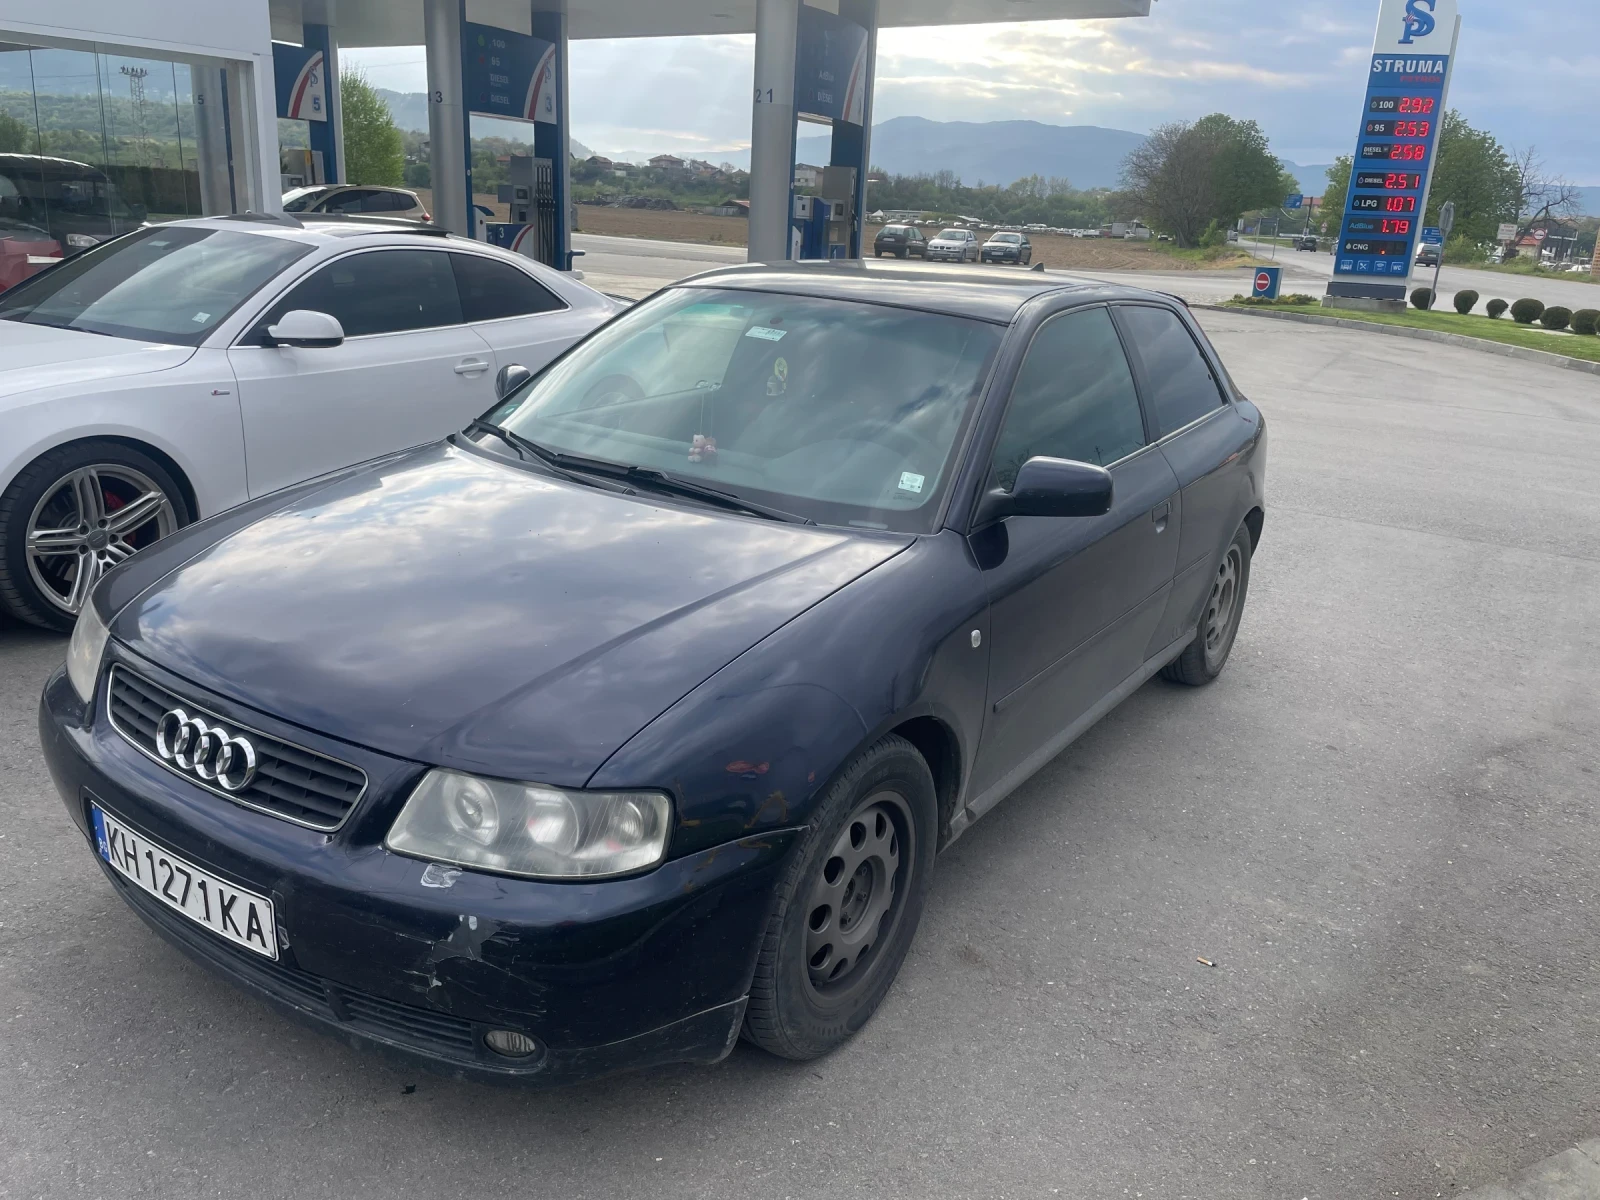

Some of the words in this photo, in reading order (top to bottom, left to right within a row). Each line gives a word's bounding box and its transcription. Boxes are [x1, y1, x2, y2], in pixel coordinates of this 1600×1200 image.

[492, 39, 506, 49] 100
[491, 56, 501, 66] 95
[1373, 59, 1444, 74] STRUMA
[489, 73, 509, 84] DIESEL
[197, 94, 205, 105] 5
[435, 90, 443, 104] 3
[490, 93, 510, 105] DIESEL
[756, 88, 762, 103] 2
[766, 88, 773, 103] 1
[313, 96, 321, 111] 5
[1378, 101, 1394, 109] 100
[1398, 97, 1434, 114] 2.92
[1374, 124, 1385, 132] 95
[1394, 121, 1430, 137] 2.53
[1390, 144, 1425, 160] 2.58
[1384, 173, 1420, 189] 2.51
[1361, 199, 1378, 207] LPG
[1386, 196, 1416, 212] 1.07
[499, 227, 505, 239] 3
[1349, 222, 1374, 230] AdBlue
[1381, 219, 1410, 234] 1.79
